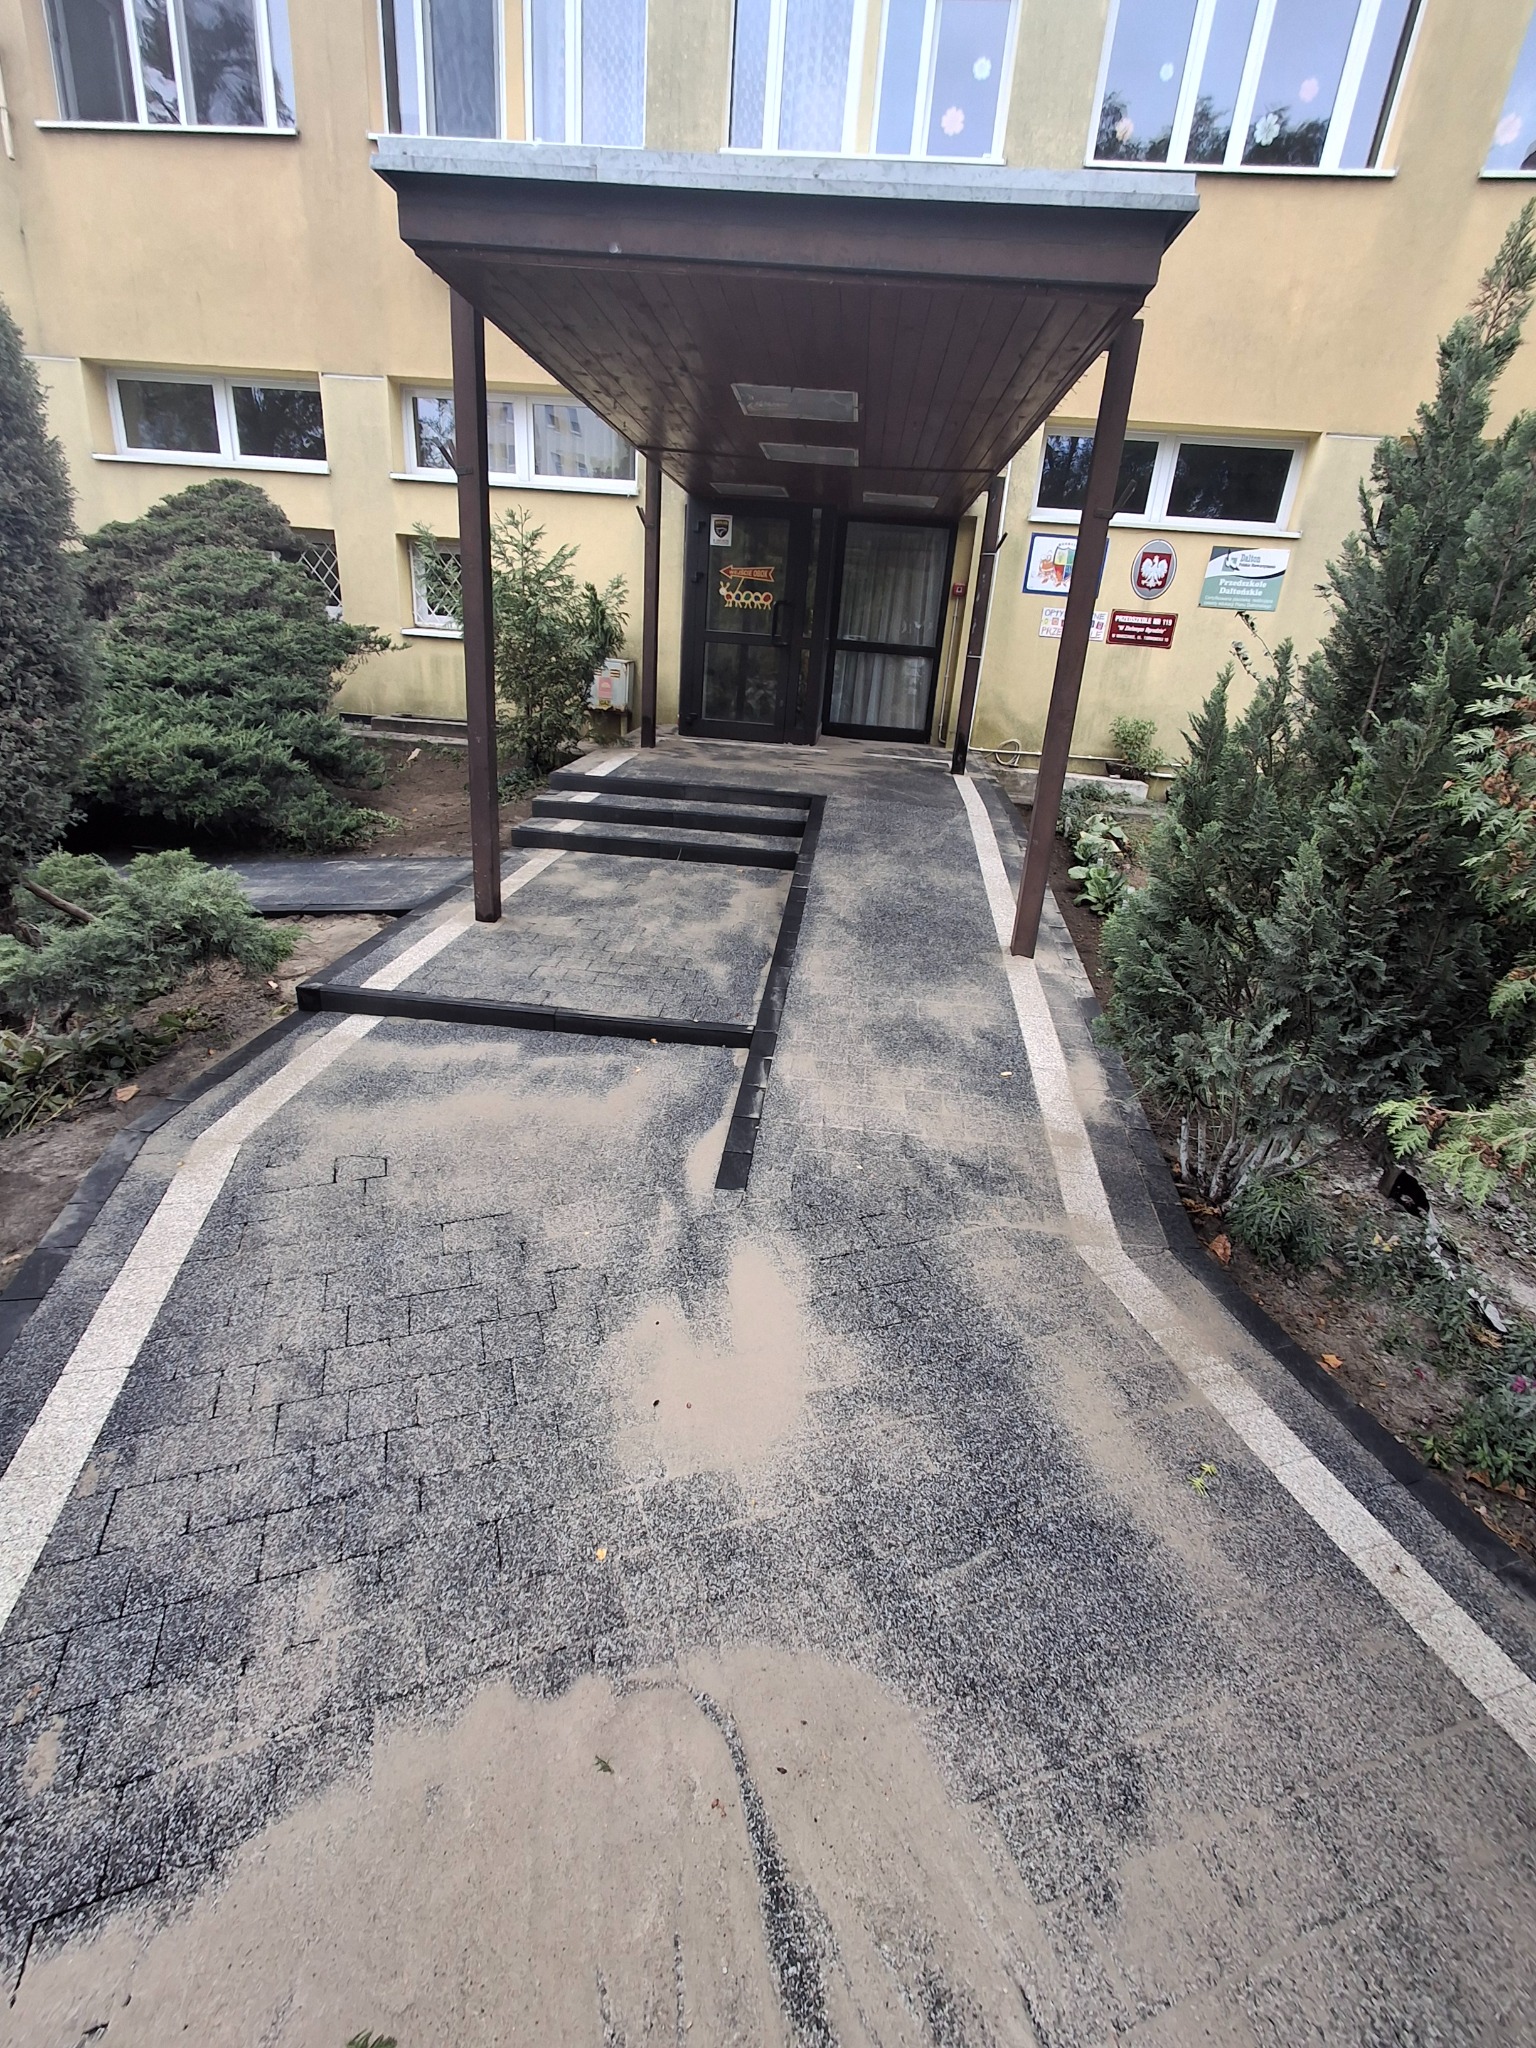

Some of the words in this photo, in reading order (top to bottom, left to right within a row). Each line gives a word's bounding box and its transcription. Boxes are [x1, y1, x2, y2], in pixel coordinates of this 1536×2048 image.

[1240, 554, 1261, 563] Dalton
[729, 569, 752, 577] WEJŚCIE
[753, 570, 768, 578] OBOK
[1219, 579, 1267, 588] Przedszkole
[1219, 587, 1263, 596] Daltońskie
